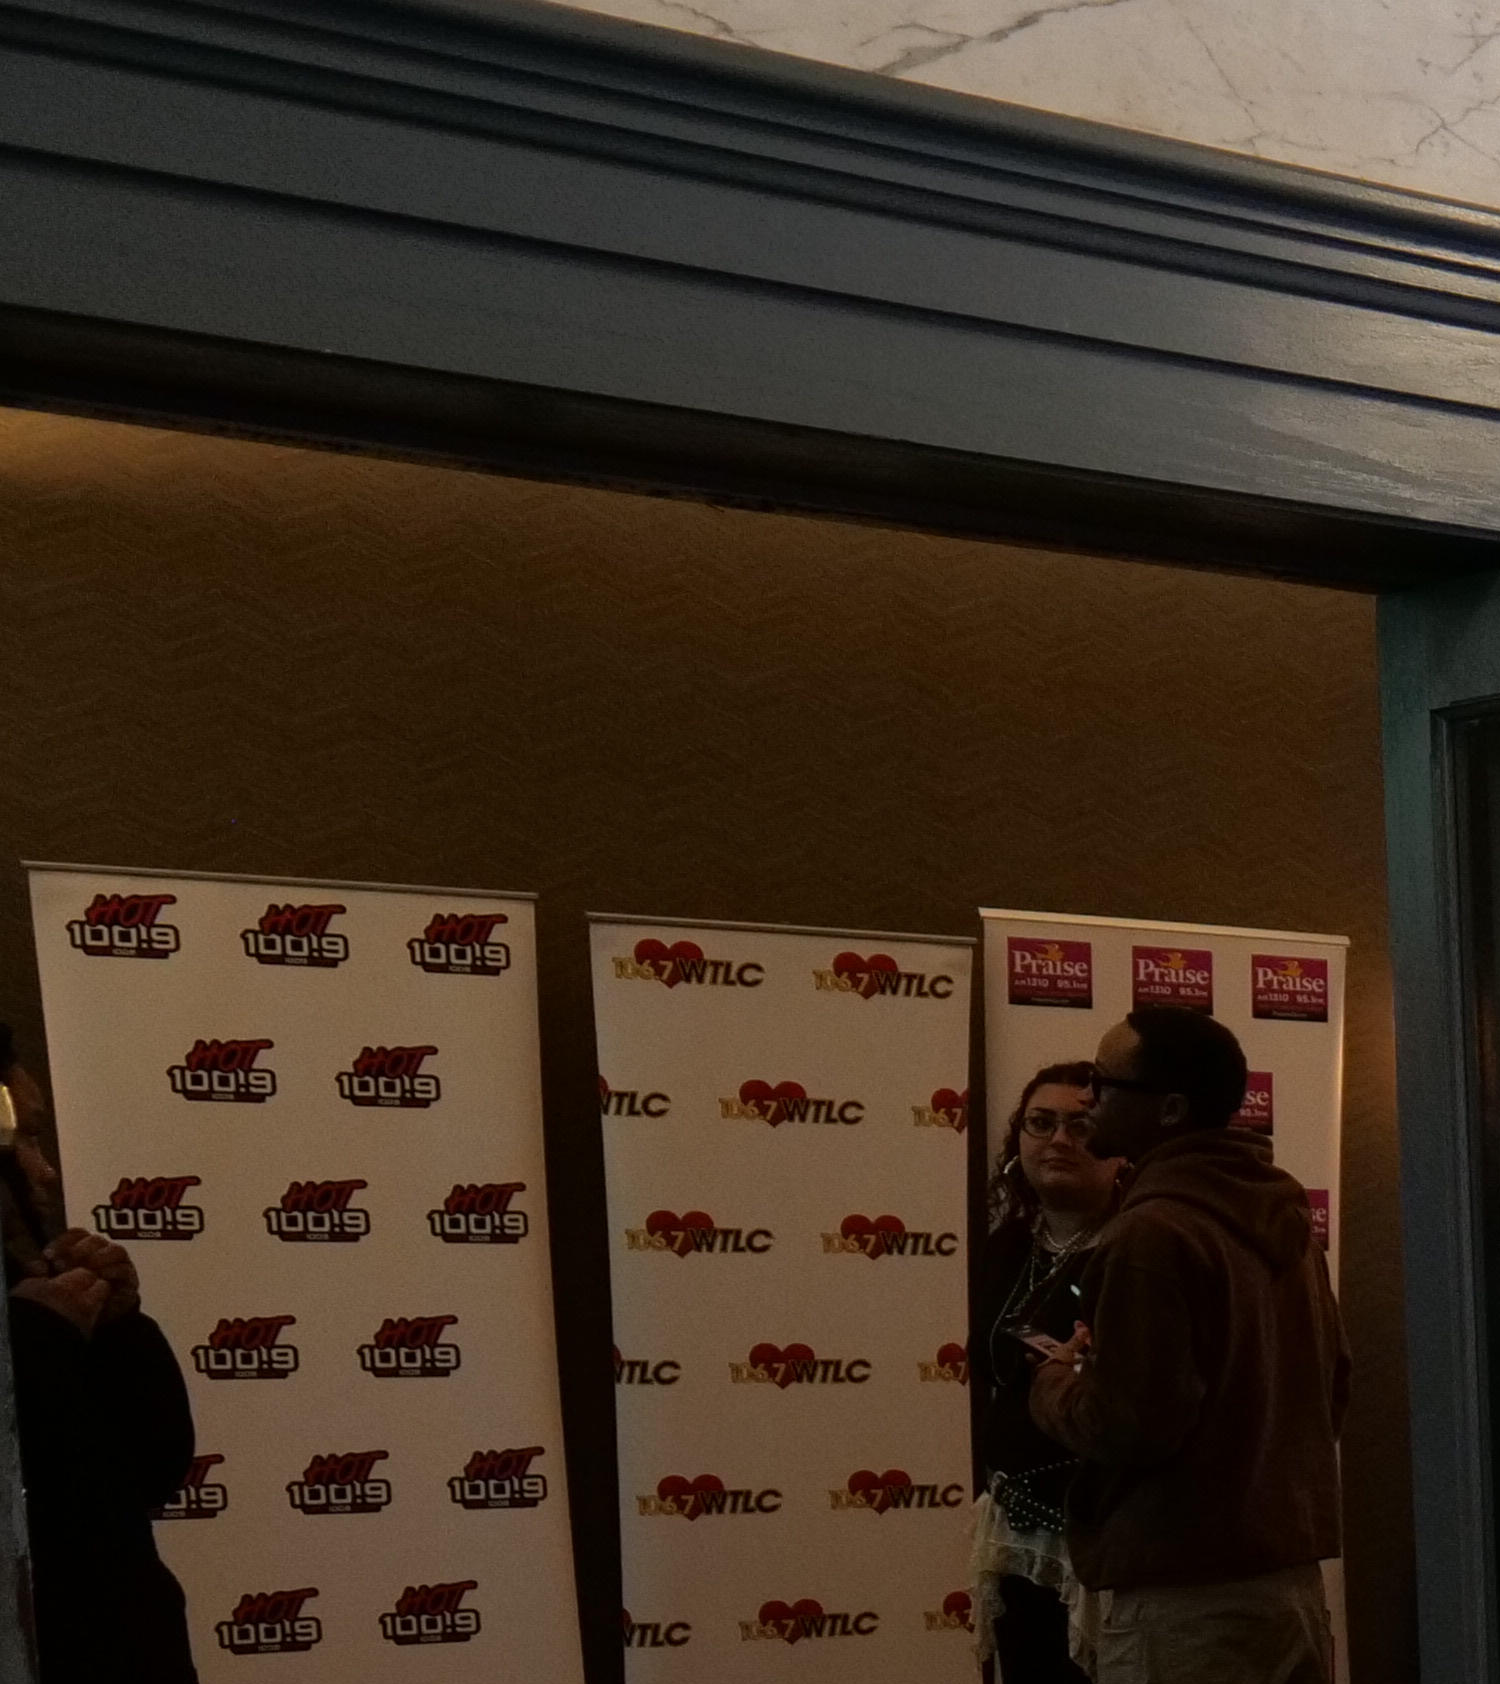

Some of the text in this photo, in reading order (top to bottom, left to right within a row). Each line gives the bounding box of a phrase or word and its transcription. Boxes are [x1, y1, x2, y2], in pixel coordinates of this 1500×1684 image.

[86, 894, 176, 926] HOT
[260, 905, 346, 934] HOT
[425, 914, 507, 944] HOT
[612, 957, 765, 987] 106.7 WTLC
[1012, 950, 1088, 977] Praise
[1136, 959, 1209, 985] Praise
[812, 970, 954, 999] 106.7 WTLC
[1255, 967, 1325, 992] Praise
[187, 1040, 273, 1071] HOT
[354, 1046, 437, 1077] HOT
[718, 1098, 864, 1125] 106.7 WTLC
[111, 1177, 200, 1210] HOT
[282, 1180, 367, 1211] HOT
[445, 1183, 525, 1214] HOT
[625, 1228, 774, 1253] 106.7 WTLC
[820, 1231, 957, 1256] 106.7 WTLC
[210, 1316, 295, 1348] HOT
[375, 1316, 457, 1348] HOT
[729, 1359, 872, 1384] 106.7 WTLC
[304, 1451, 388, 1485] HOT
[464, 1447, 544, 1480] HOT
[635, 1489, 783, 1516] 106.7 WTLC
[829, 1483, 965, 1510] 106.7 WTLC
[234, 1588, 318, 1622] HOT
[397, 1581, 477, 1616] HOT
[738, 1612, 879, 1641] 106.7 WTLC
